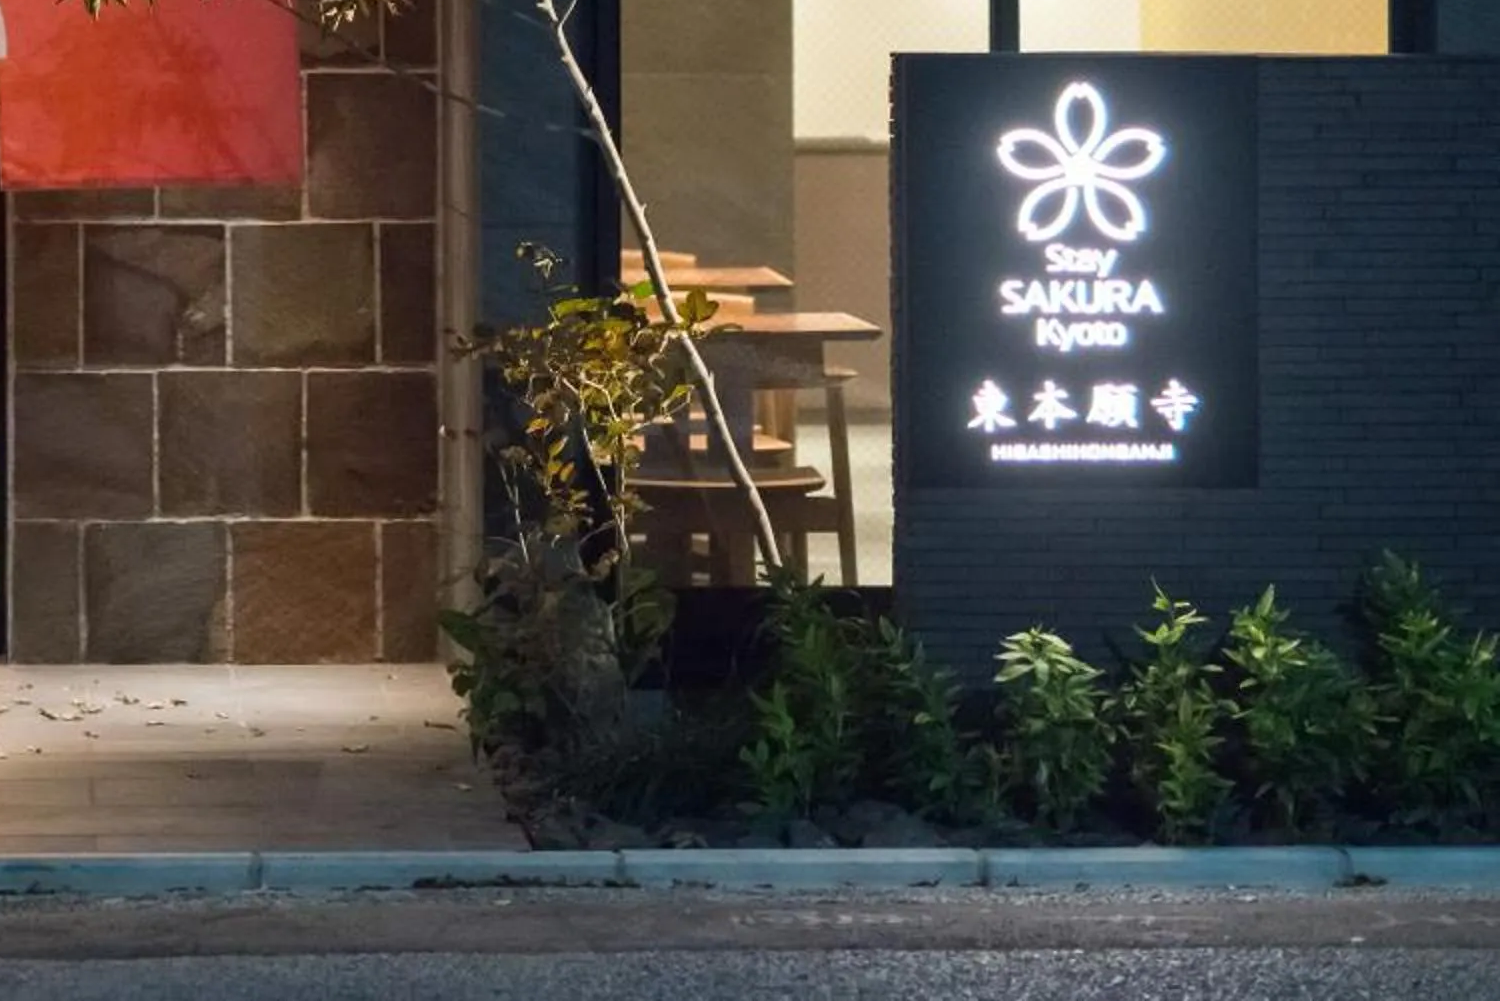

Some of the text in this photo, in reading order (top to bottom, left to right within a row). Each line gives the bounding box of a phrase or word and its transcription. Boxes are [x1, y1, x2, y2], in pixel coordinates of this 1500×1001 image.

[1045, 244, 1118, 277] Stay
[1000, 280, 1163, 314] SAKURA
[1036, 318, 1128, 351] Kyoto
[967, 379, 1199, 431] 東本願寺
